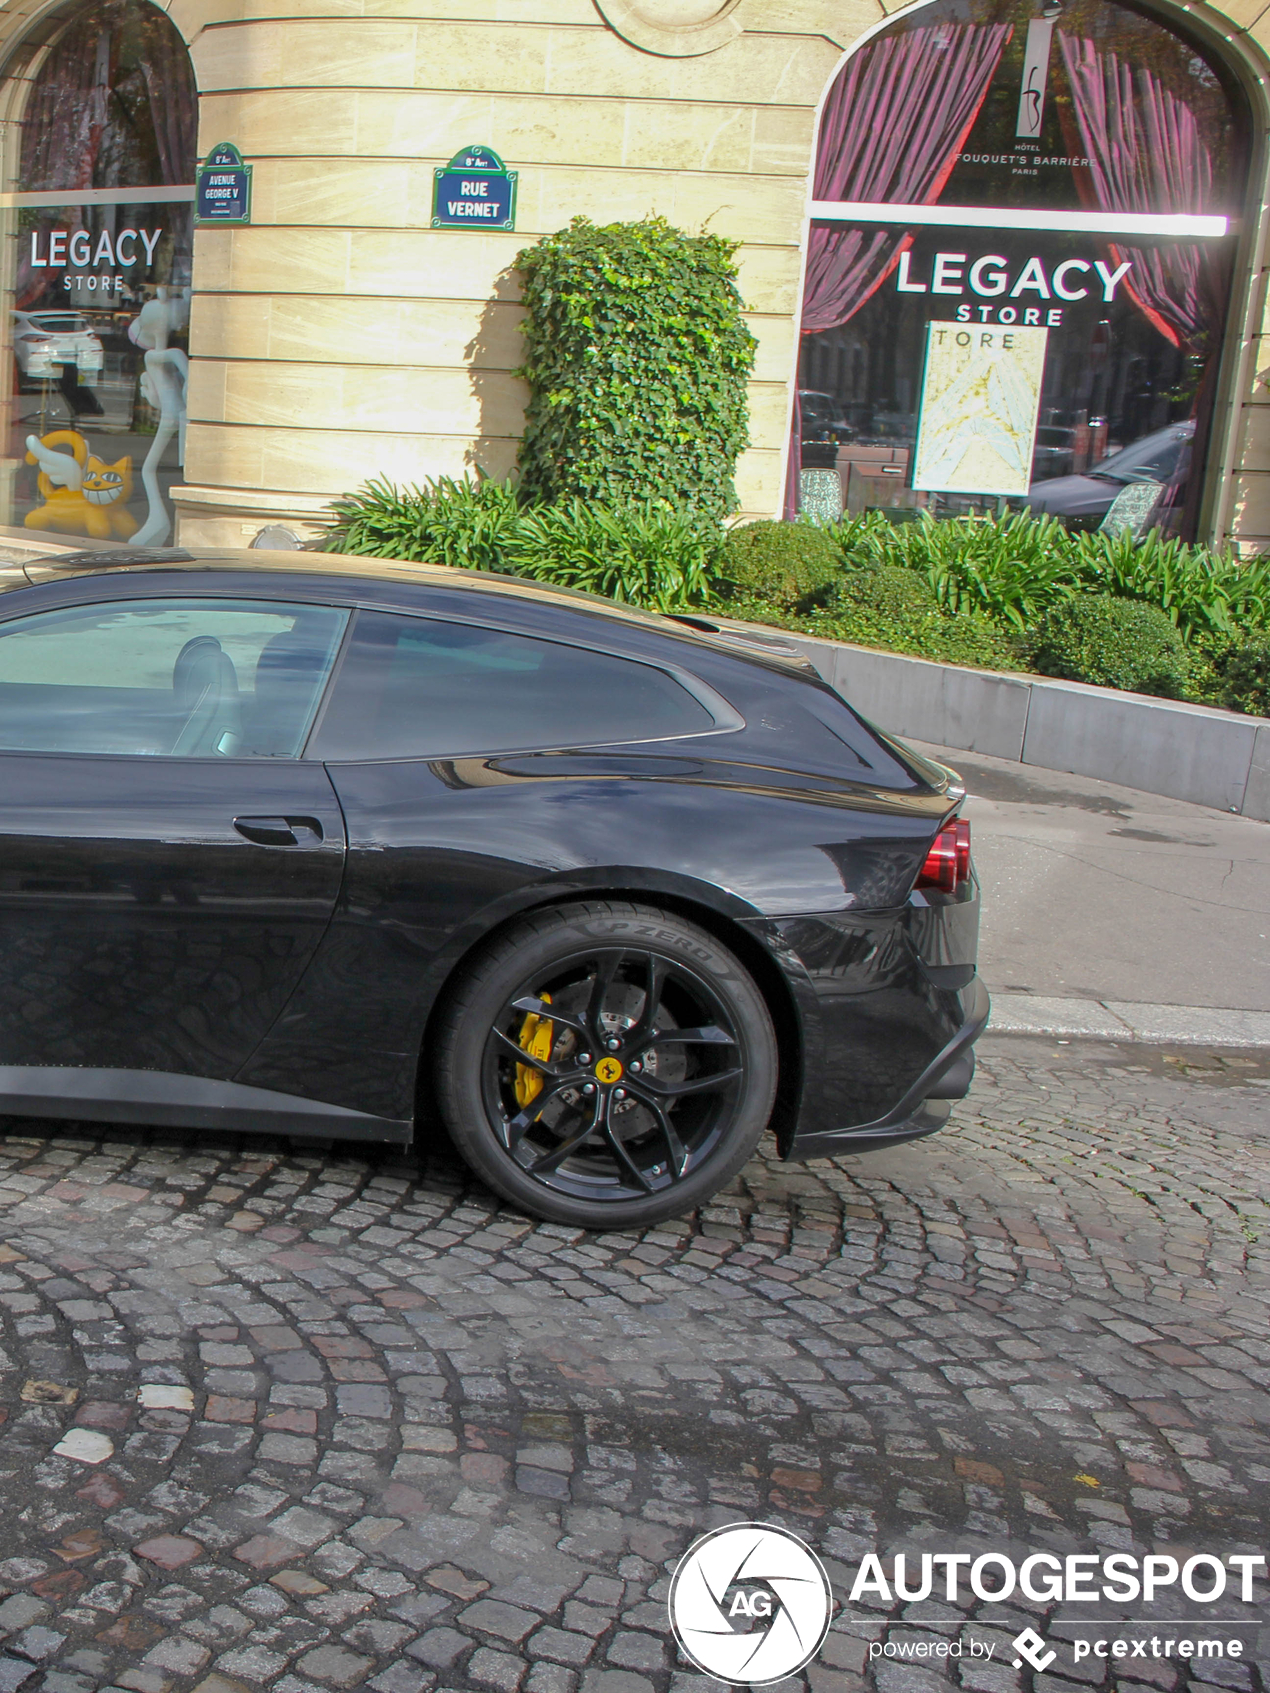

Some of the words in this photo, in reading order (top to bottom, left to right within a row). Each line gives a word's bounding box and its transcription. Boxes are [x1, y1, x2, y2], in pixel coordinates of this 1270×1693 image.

[1014, 143, 1041, 152] HÔTEL
[955, 153, 1027, 165] FOUQUET'S
[209, 174, 236, 186] AVENUE
[205, 188, 231, 199] GEORGE
[232, 188, 239, 199] V
[460, 181, 489, 197] RUE
[447, 201, 500, 218] VERNET
[31, 228, 162, 267] LEGACY
[63, 274, 123, 291] STORE
[896, 251, 1132, 303] LEGACY
[955, 303, 1063, 328] STORE
[634, 925, 713, 962] ZERO
